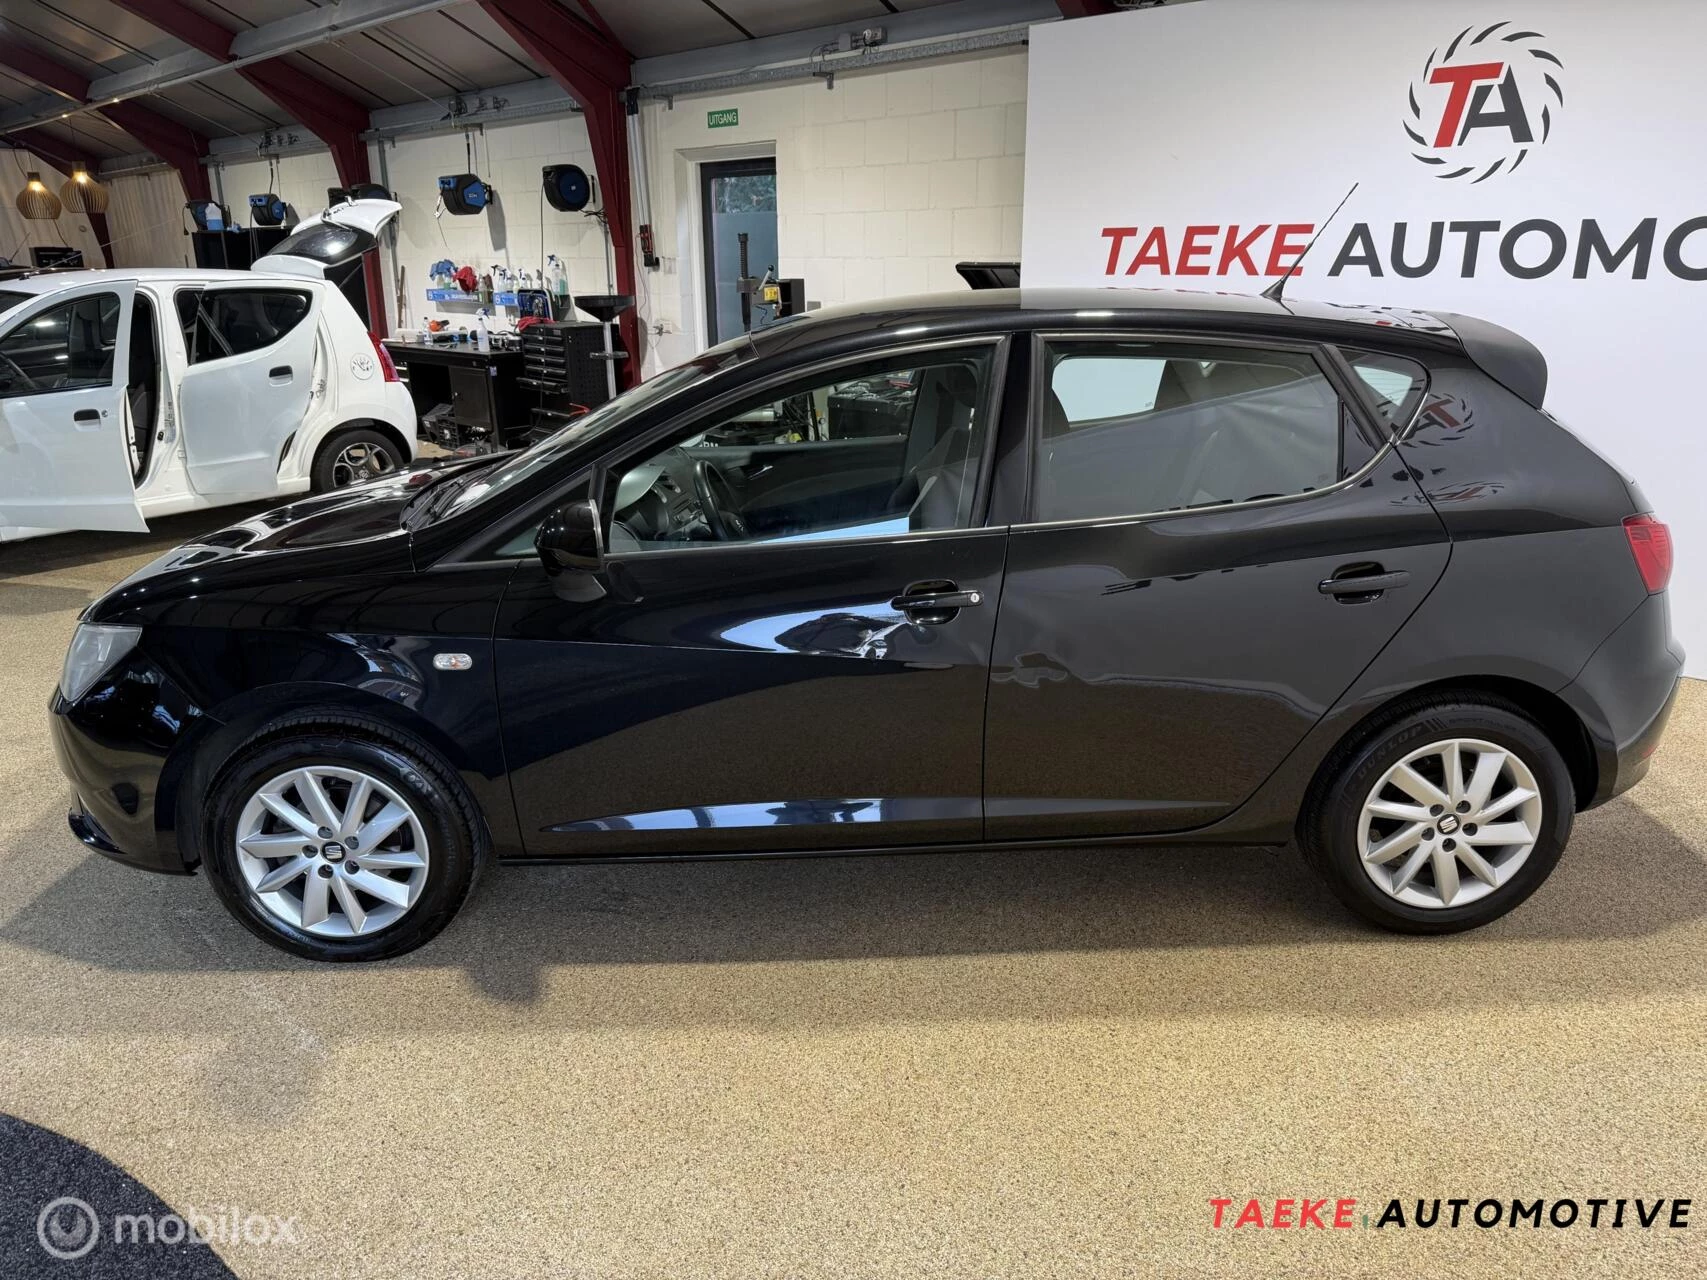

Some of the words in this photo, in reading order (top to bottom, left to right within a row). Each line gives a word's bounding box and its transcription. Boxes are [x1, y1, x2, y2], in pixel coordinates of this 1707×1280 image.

[708, 112, 737, 125] UITGANG
[1431, 62, 1534, 148] TA
[1101, 223, 1314, 277] TAEKE
[1328, 216, 1707, 281] AUTOMO
[1357, 725, 1423, 780] DUNLOP
